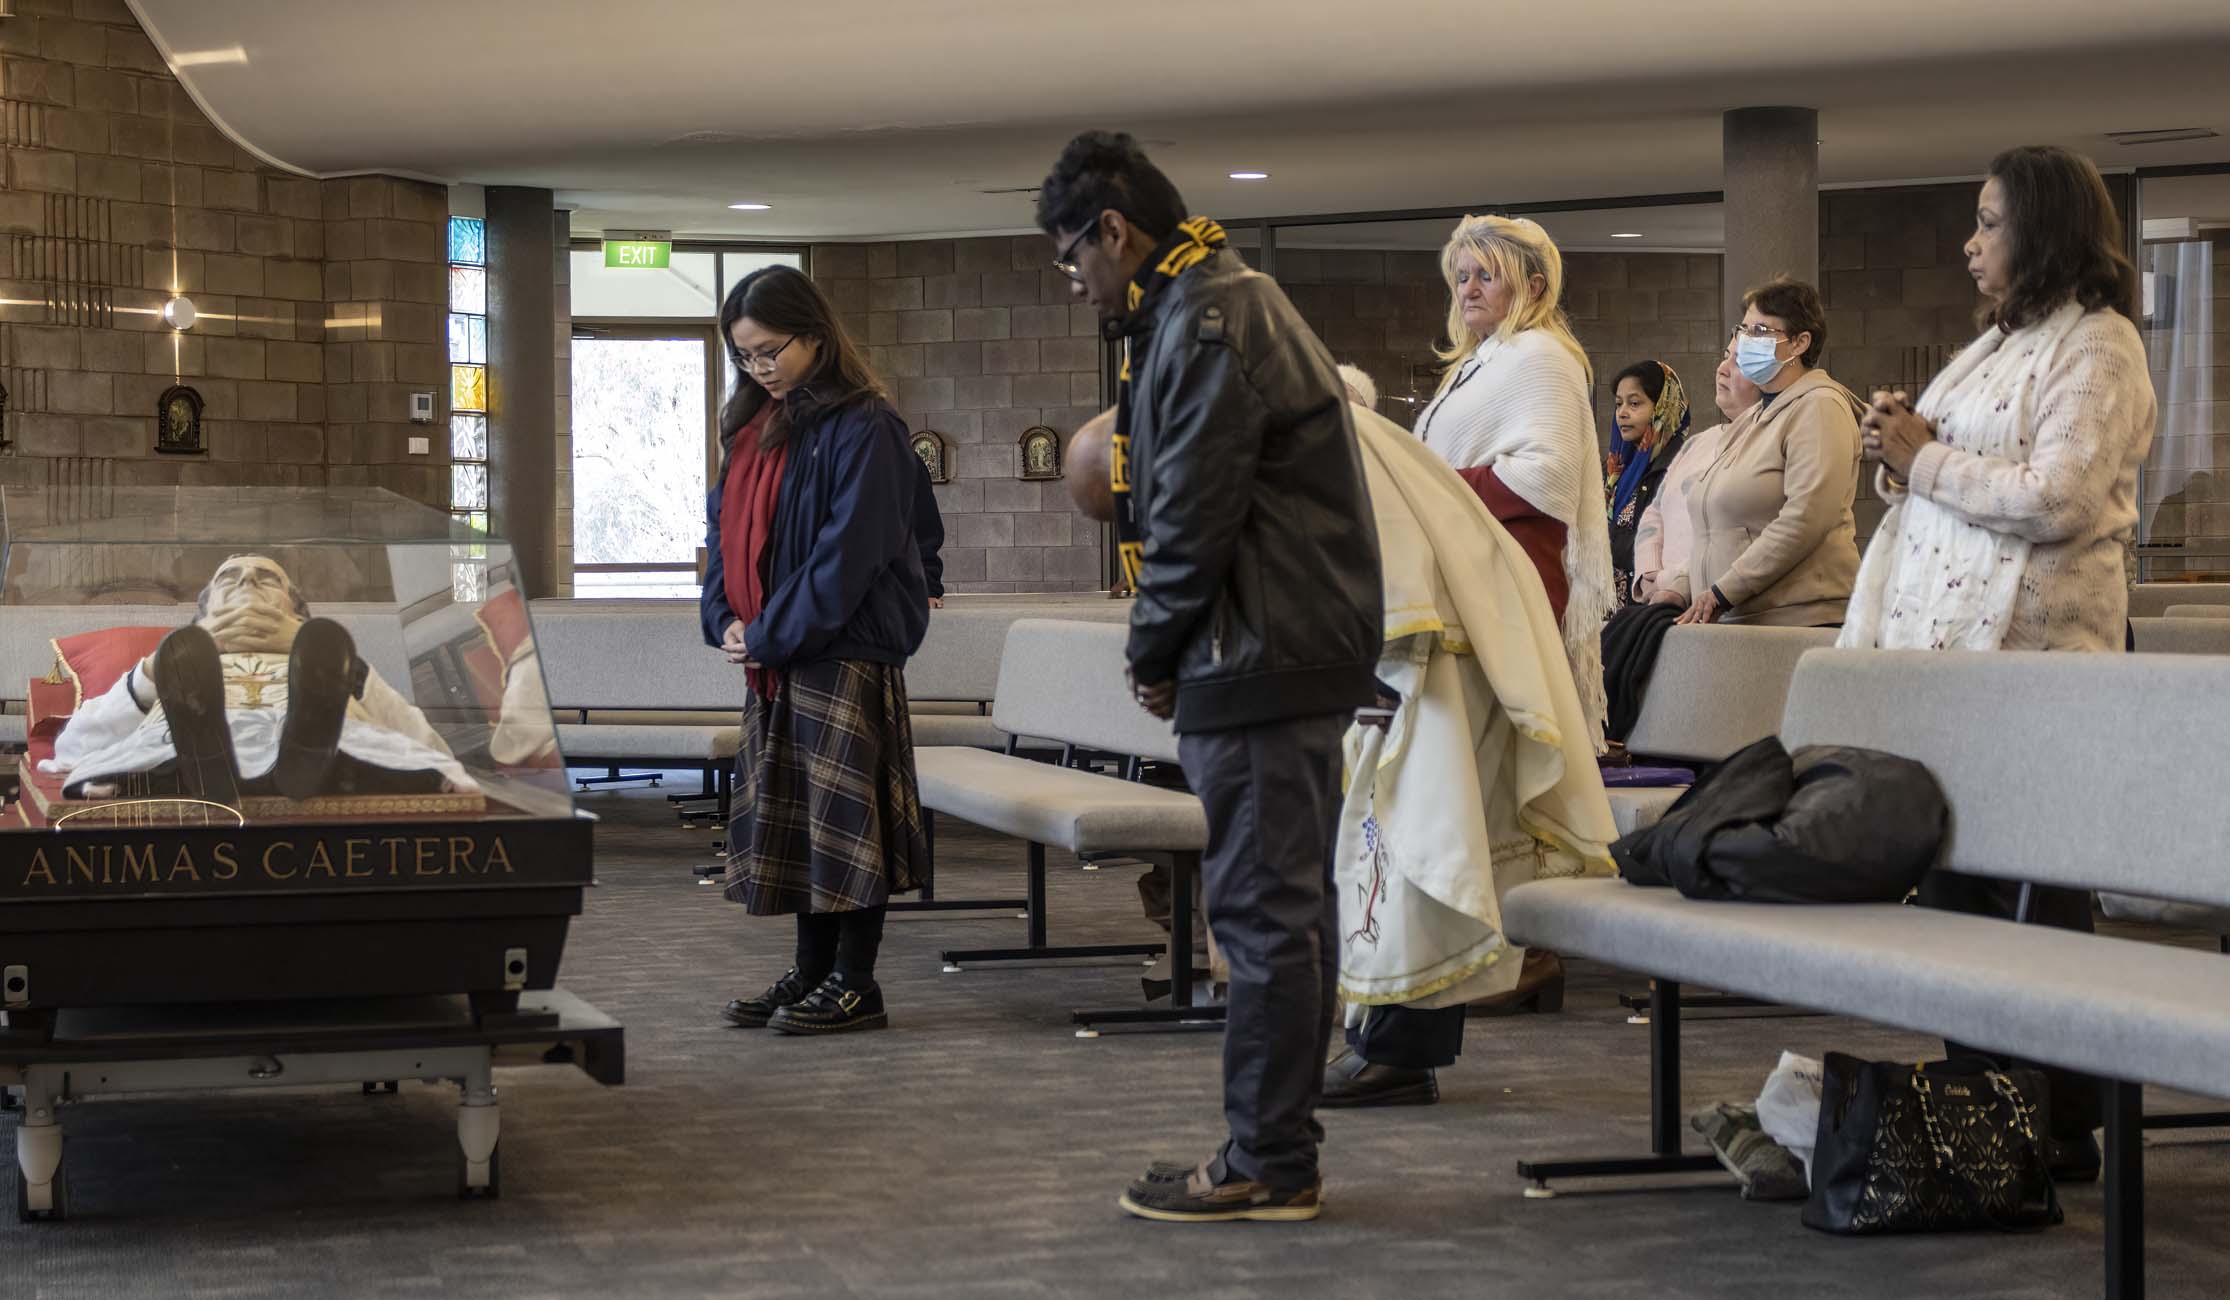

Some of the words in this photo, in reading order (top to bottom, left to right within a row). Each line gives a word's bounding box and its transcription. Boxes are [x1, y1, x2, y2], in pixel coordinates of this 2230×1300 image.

[619, 245, 656, 265] EXIT
[23, 842, 239, 885] ANIMAS
[262, 836, 515, 880] CAETERA
